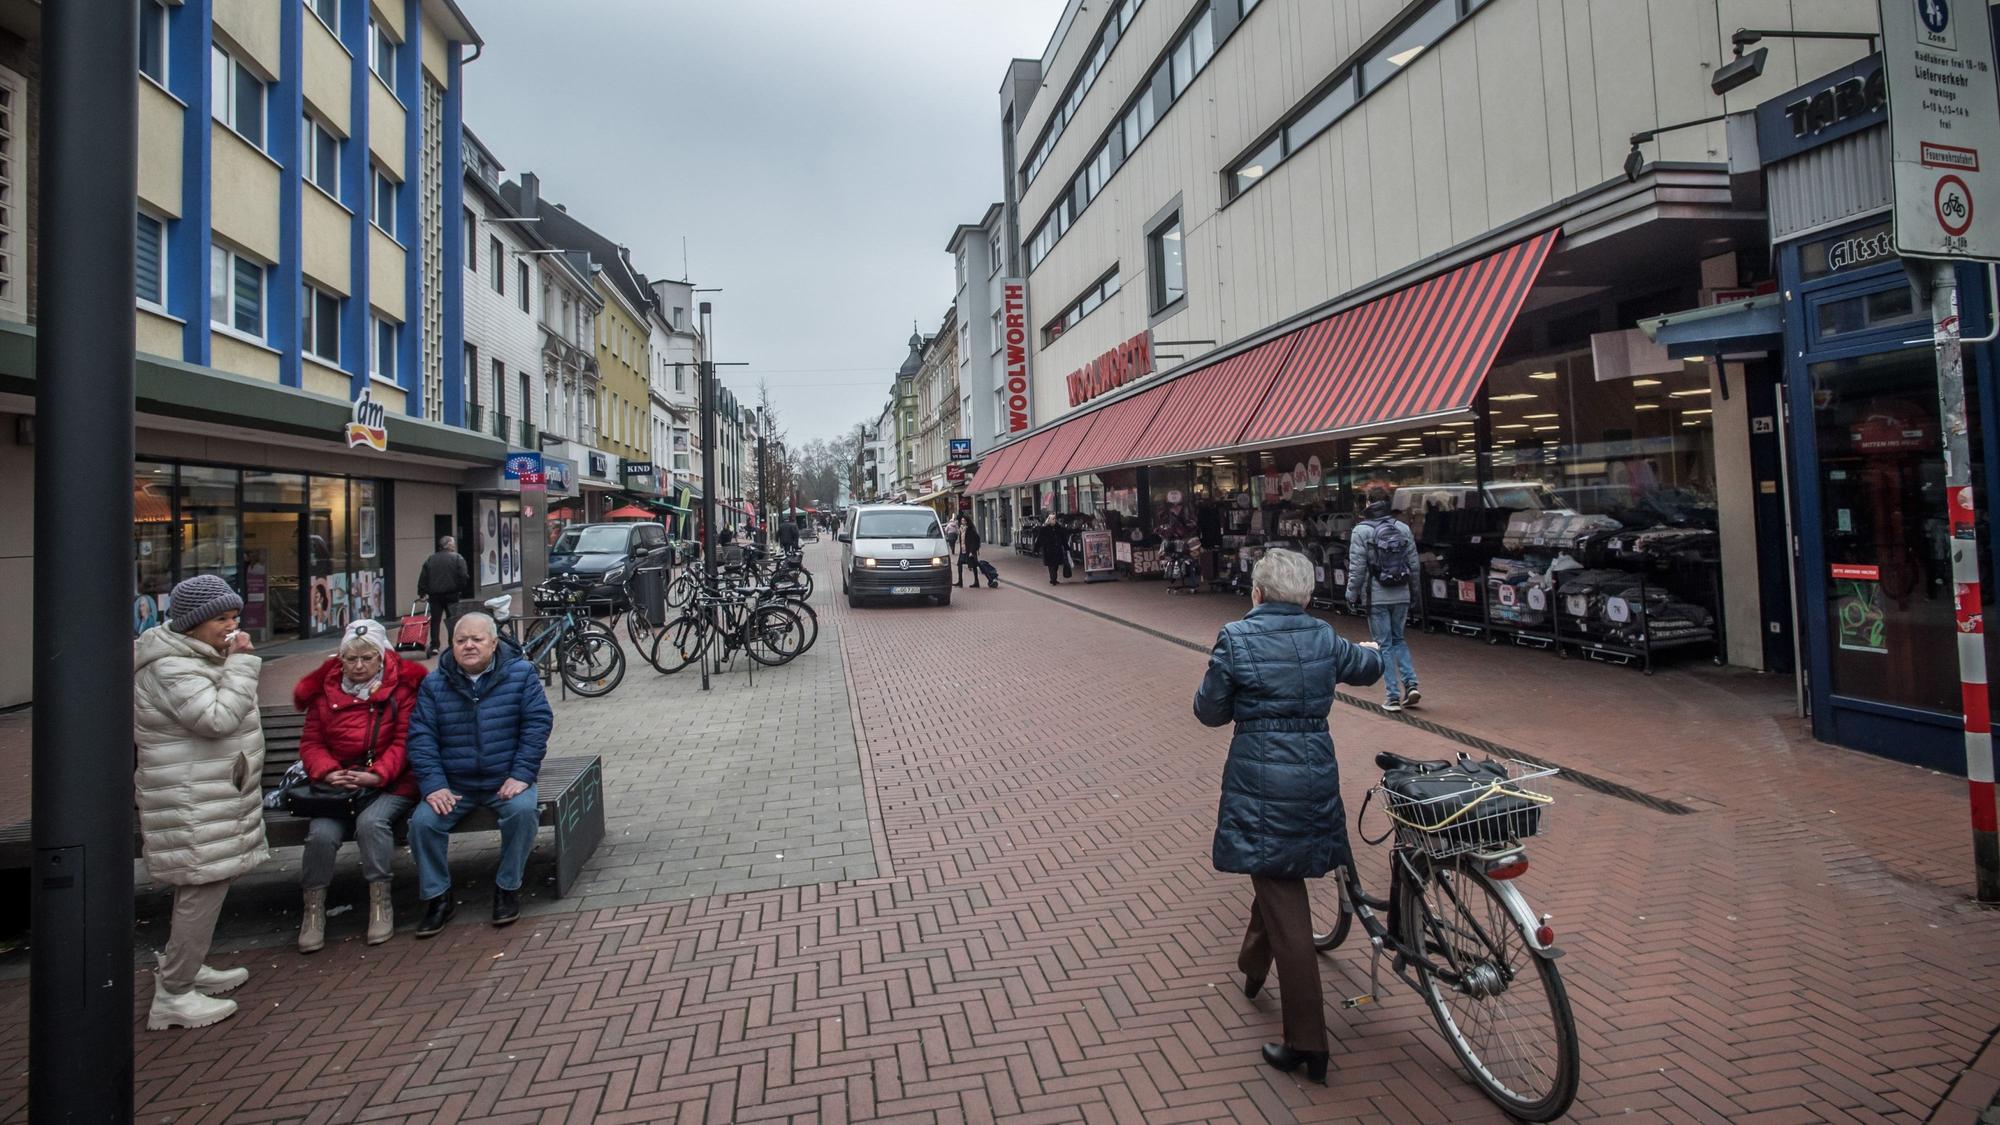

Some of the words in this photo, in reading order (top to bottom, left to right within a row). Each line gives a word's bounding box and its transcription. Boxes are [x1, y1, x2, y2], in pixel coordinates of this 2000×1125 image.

[1927, 31, 1946, 43] Zone
[1915, 50, 1949, 66] Radfahrer
[1951, 58, 1964, 69] frei
[1915, 65, 1968, 87] Lieferverkehr
[1928, 88, 1956, 101] werktags
[1939, 119, 1951, 129] frei
[1005, 284, 1028, 433] WOOLWORTH
[1066, 329, 1155, 408] WOOLWORTH
[358, 391, 383, 428] dm
[1755, 420, 1770, 431] 2a
[627, 465, 650, 473] KIND
